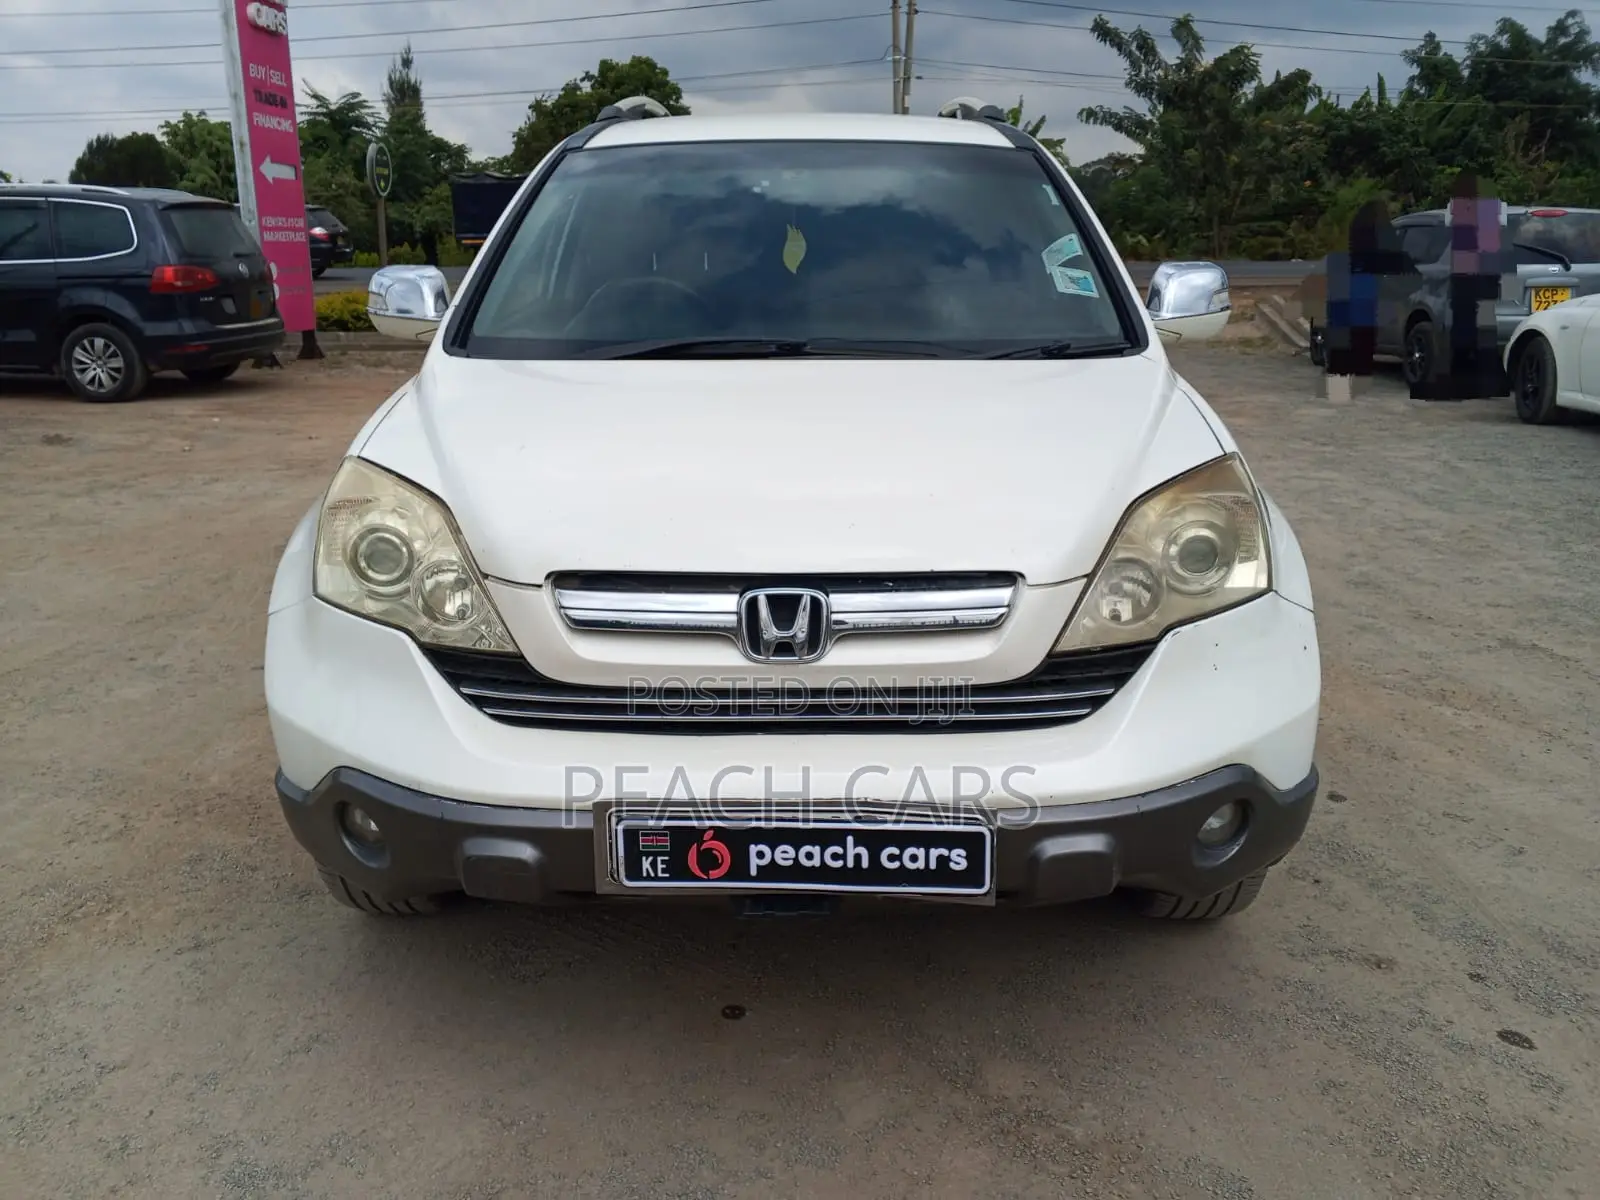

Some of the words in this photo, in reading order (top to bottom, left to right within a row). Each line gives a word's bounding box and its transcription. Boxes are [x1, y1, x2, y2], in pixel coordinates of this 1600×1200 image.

[246, 2, 287, 35] CARS
[249, 63, 266, 80] BUY
[270, 69, 287, 87] SELL
[253, 112, 293, 132] FINANCING
[263, 231, 306, 242] MARKETPLACE
[1535, 288, 1558, 300] KCP
[642, 856, 670, 877] KE
[748, 835, 869, 877] peach
[880, 846, 968, 871] cars
